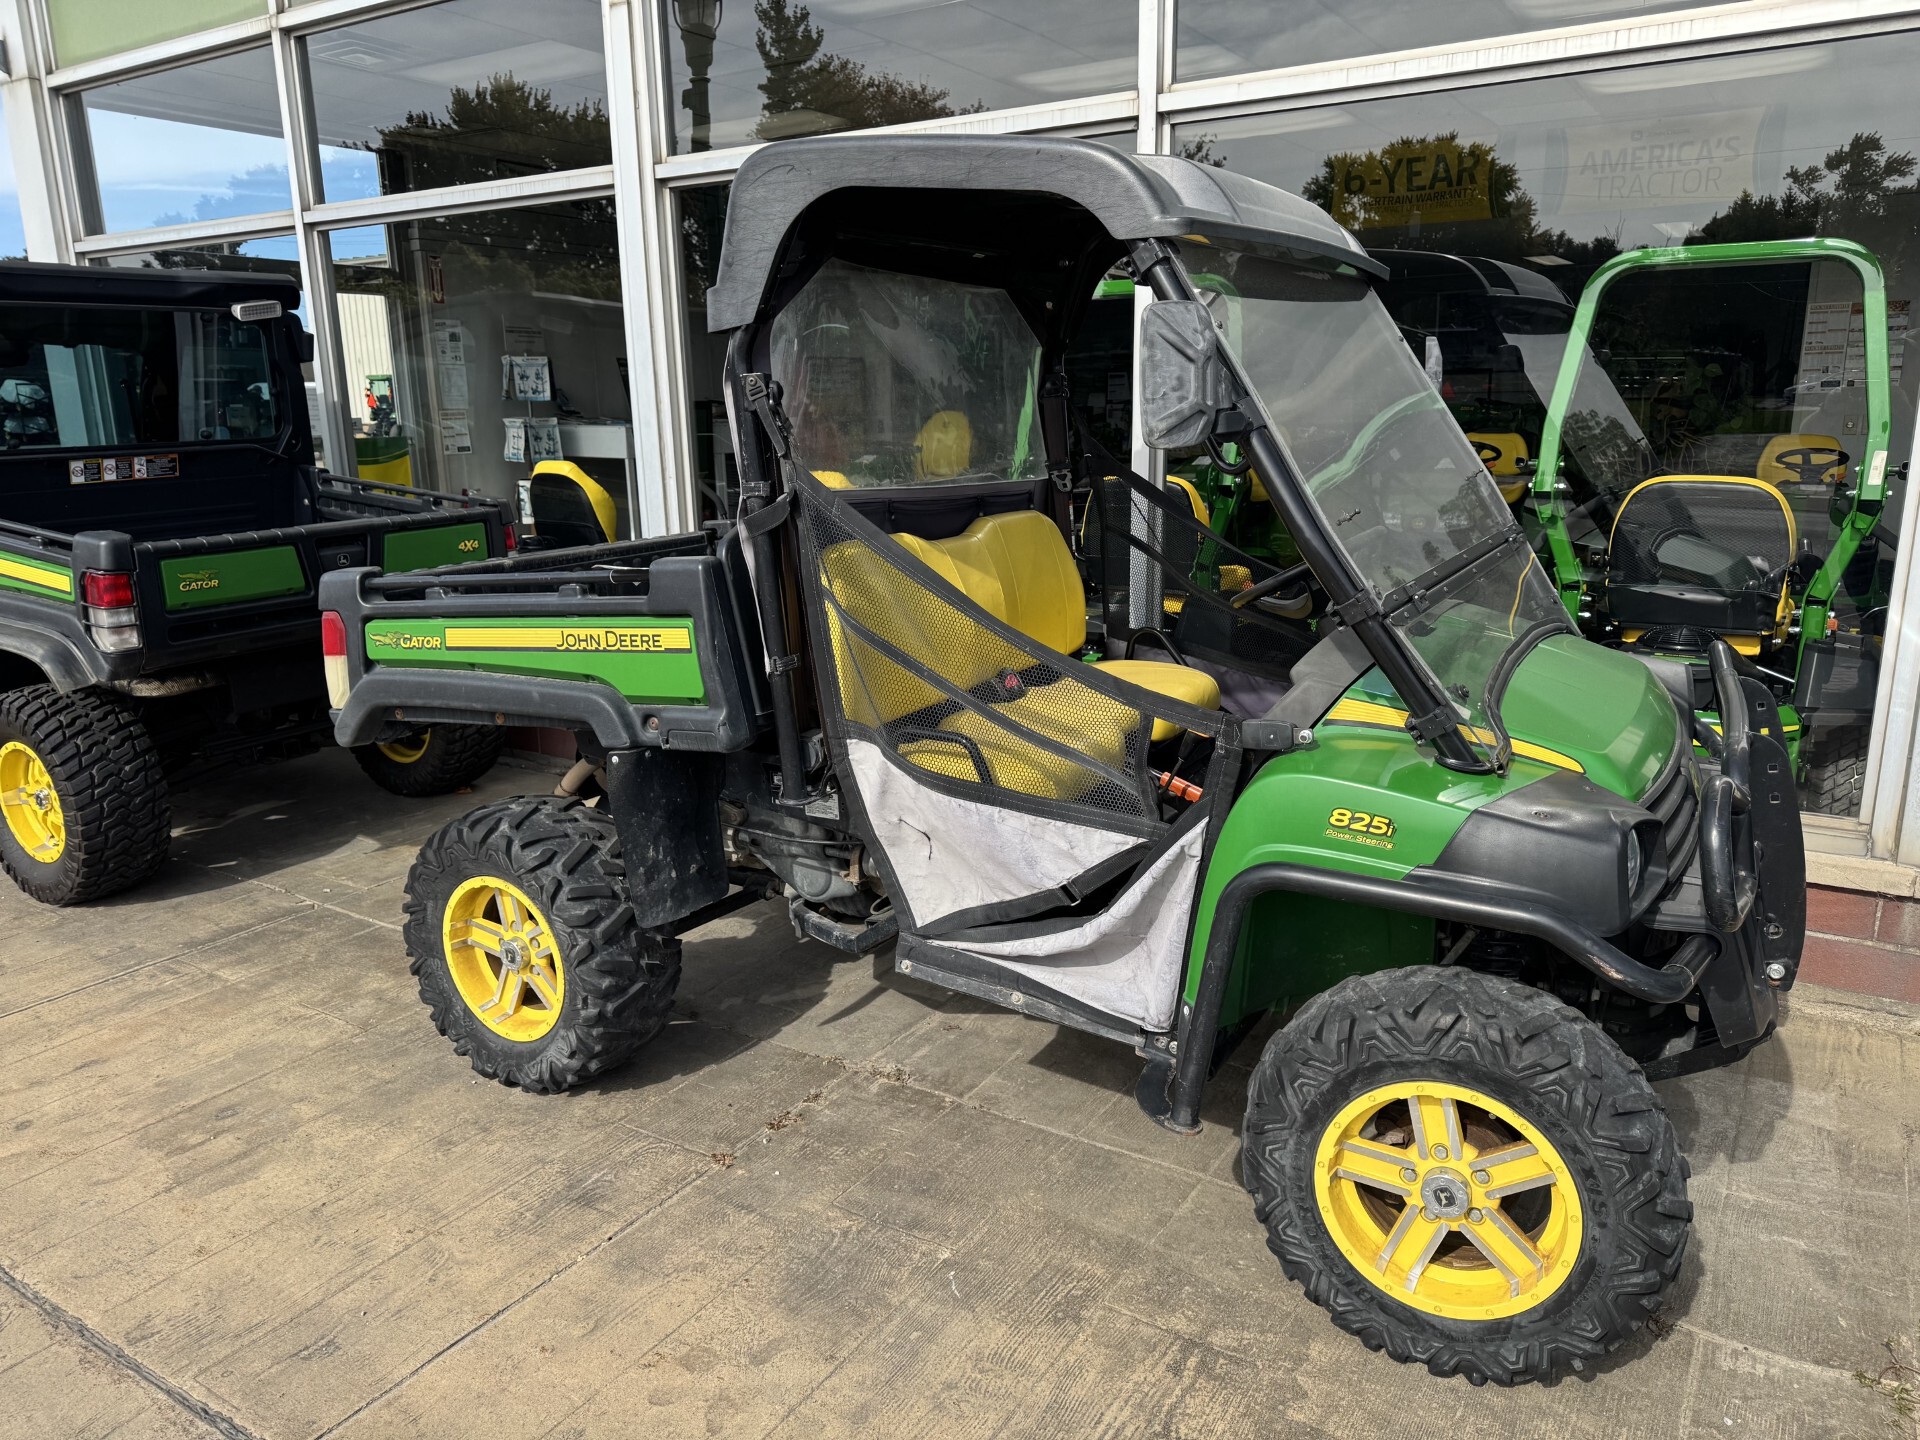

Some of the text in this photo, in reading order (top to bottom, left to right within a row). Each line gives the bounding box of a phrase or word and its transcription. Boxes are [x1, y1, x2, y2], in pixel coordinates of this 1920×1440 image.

[1580, 135, 1740, 175] AMERICA'S
[1344, 150, 1480, 195] 6-YEAR
[1592, 166, 1722, 201] TRACTOR
[1415, 186, 1477, 204] WARRANTY
[179, 579, 219, 591] GATOR
[400, 633, 442, 649] GATOR
[556, 630, 663, 649] JOHN DEERE
[1328, 807, 1395, 838] 825i
[1325, 828, 1395, 850] Power Steering
